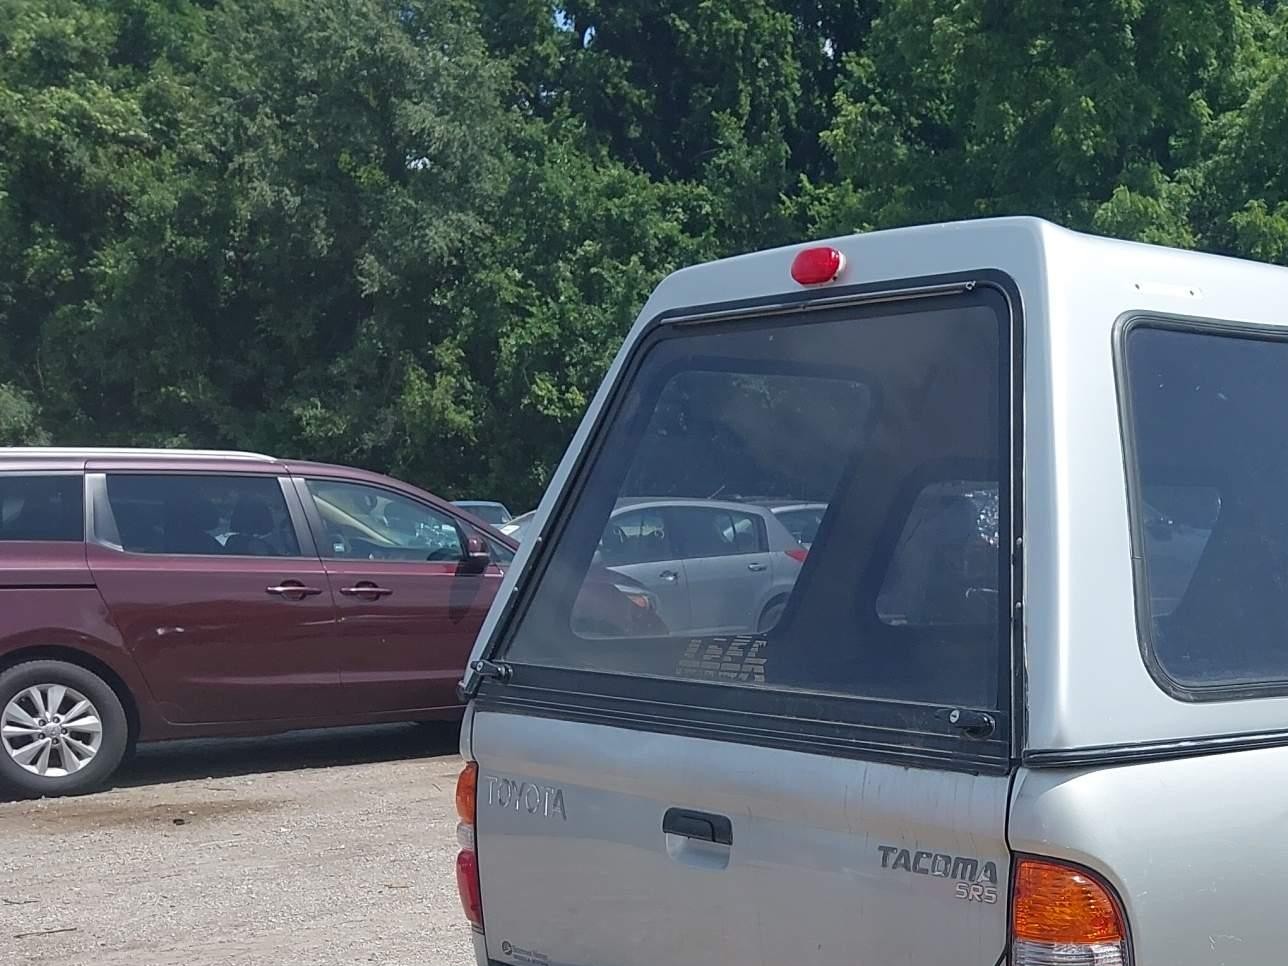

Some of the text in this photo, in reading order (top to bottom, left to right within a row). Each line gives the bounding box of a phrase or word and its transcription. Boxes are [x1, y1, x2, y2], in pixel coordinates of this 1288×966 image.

[485, 776, 568, 821] TOYOTA
[878, 845, 998, 885] TACOMA
[955, 882, 998, 905] SRS
